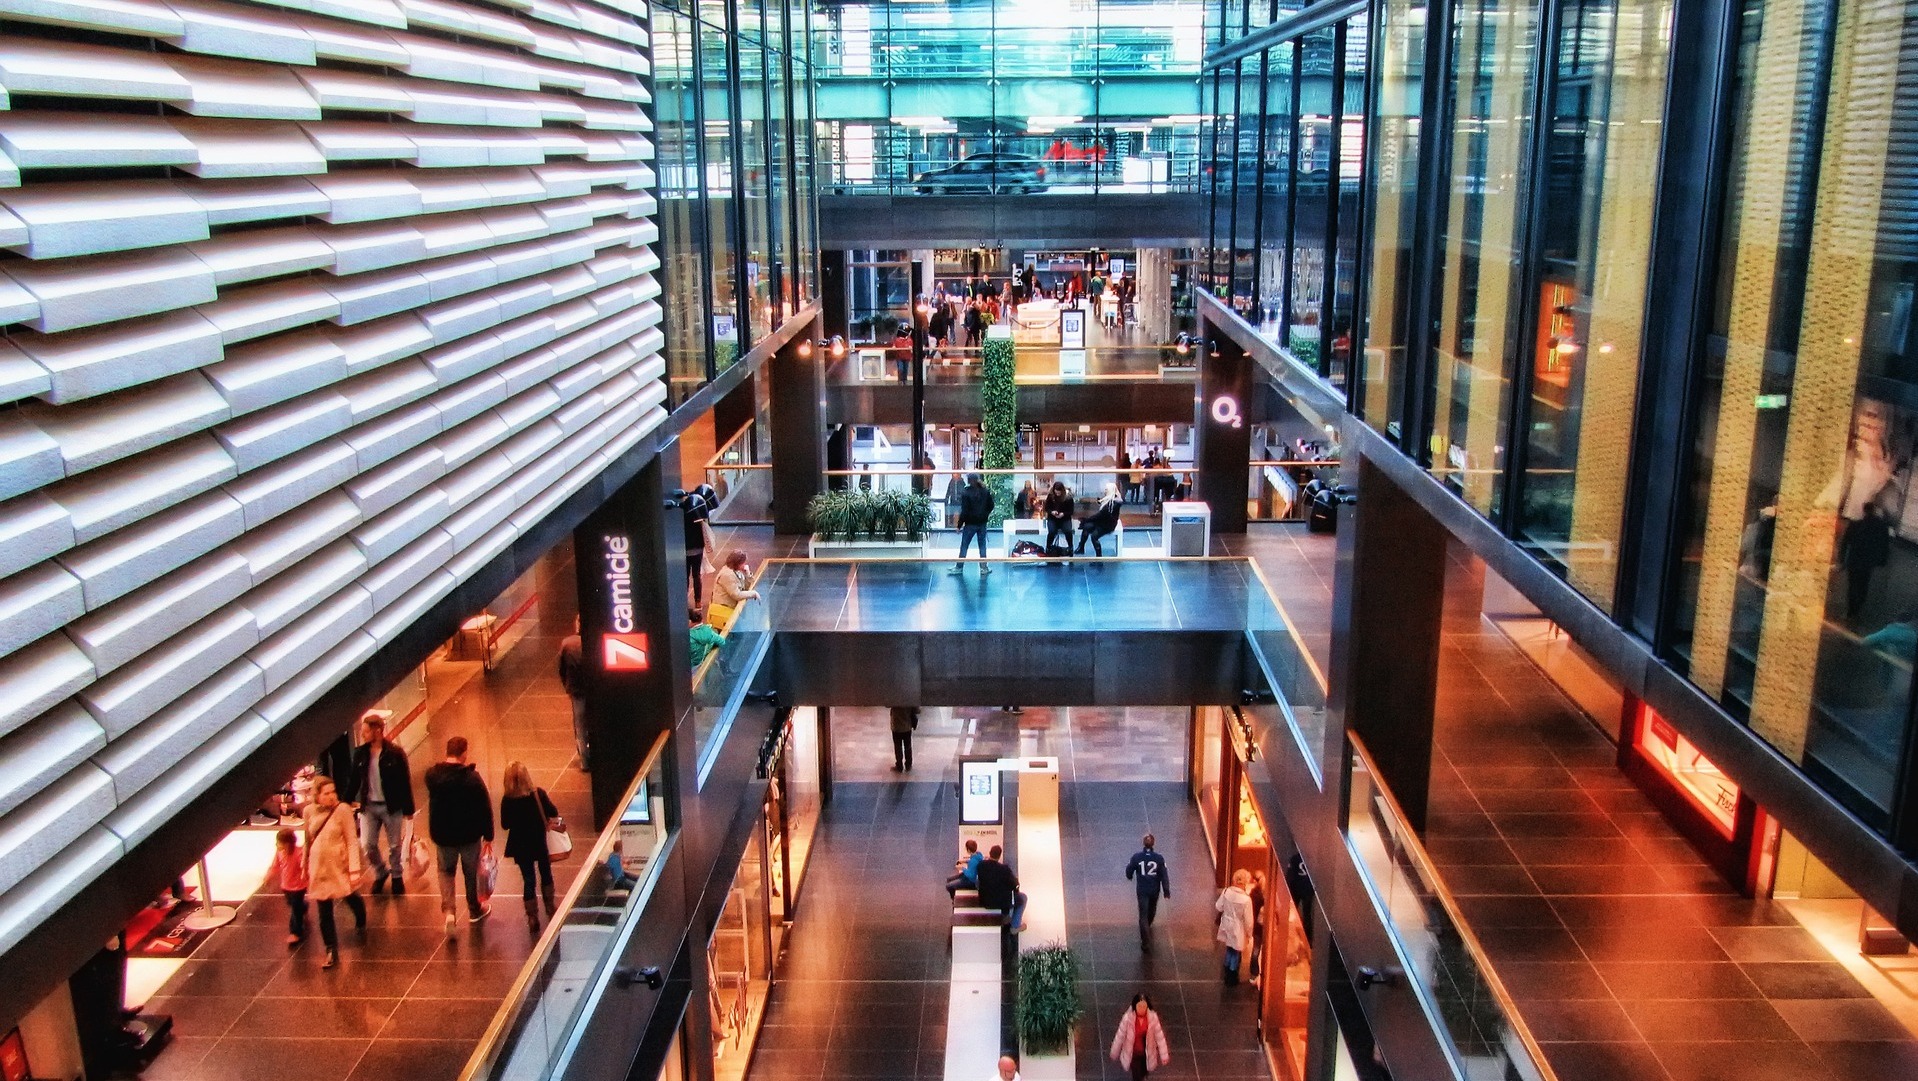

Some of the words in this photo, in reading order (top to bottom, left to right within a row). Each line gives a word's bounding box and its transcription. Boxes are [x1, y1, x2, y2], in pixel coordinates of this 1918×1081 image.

[1211, 396, 1242, 428] O2
[605, 637, 647, 666] 7
[1138, 860, 1158, 876] 12
